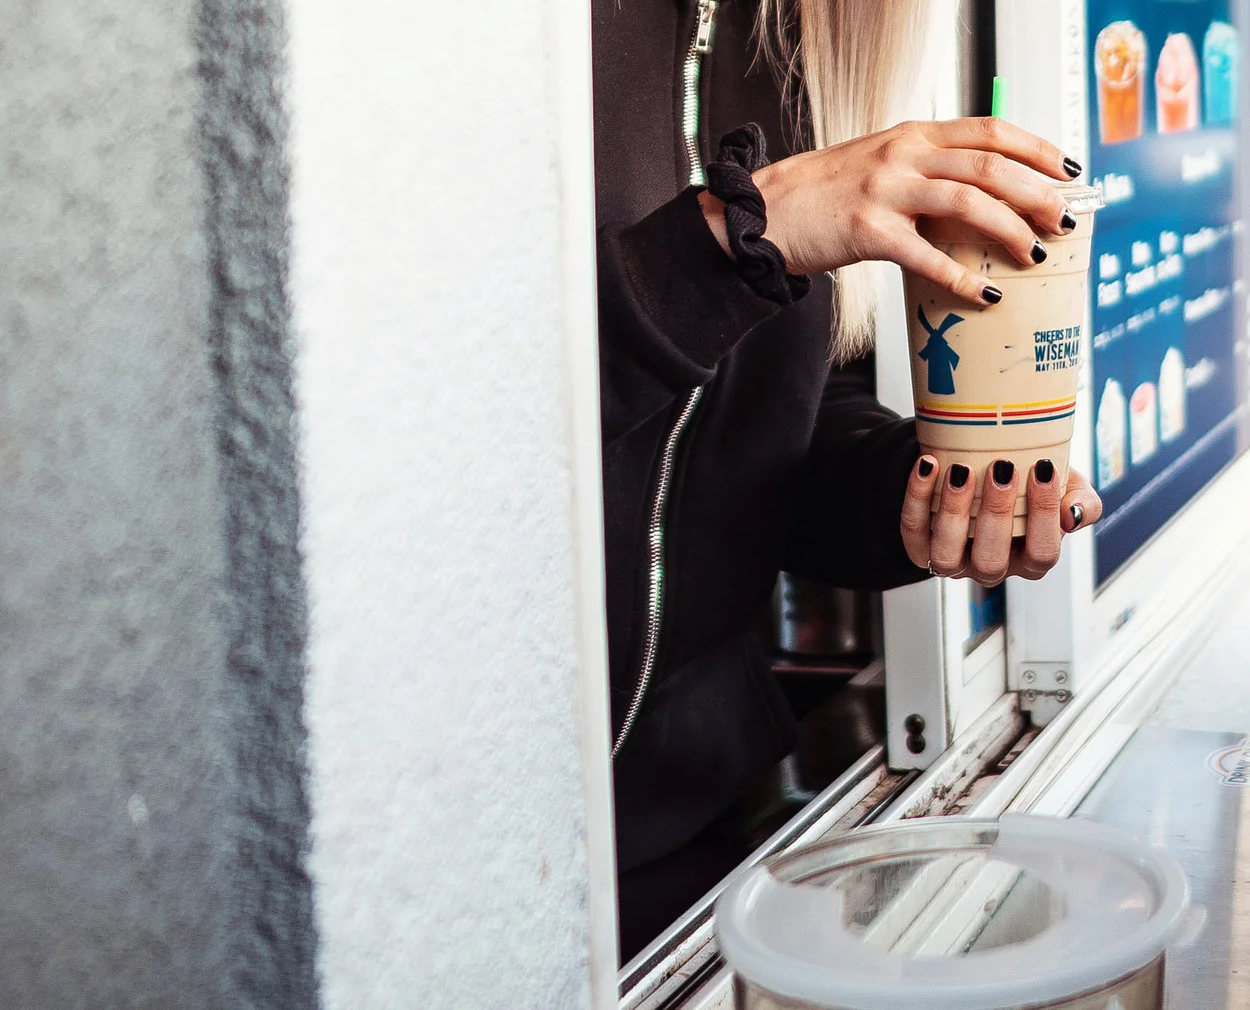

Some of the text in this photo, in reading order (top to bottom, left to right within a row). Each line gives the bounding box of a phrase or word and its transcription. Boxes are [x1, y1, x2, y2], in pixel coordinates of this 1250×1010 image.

[1034, 329, 1064, 343] CHEERS
[1065, 328, 1072, 339] TO
[1035, 363, 1050, 372] MAY
